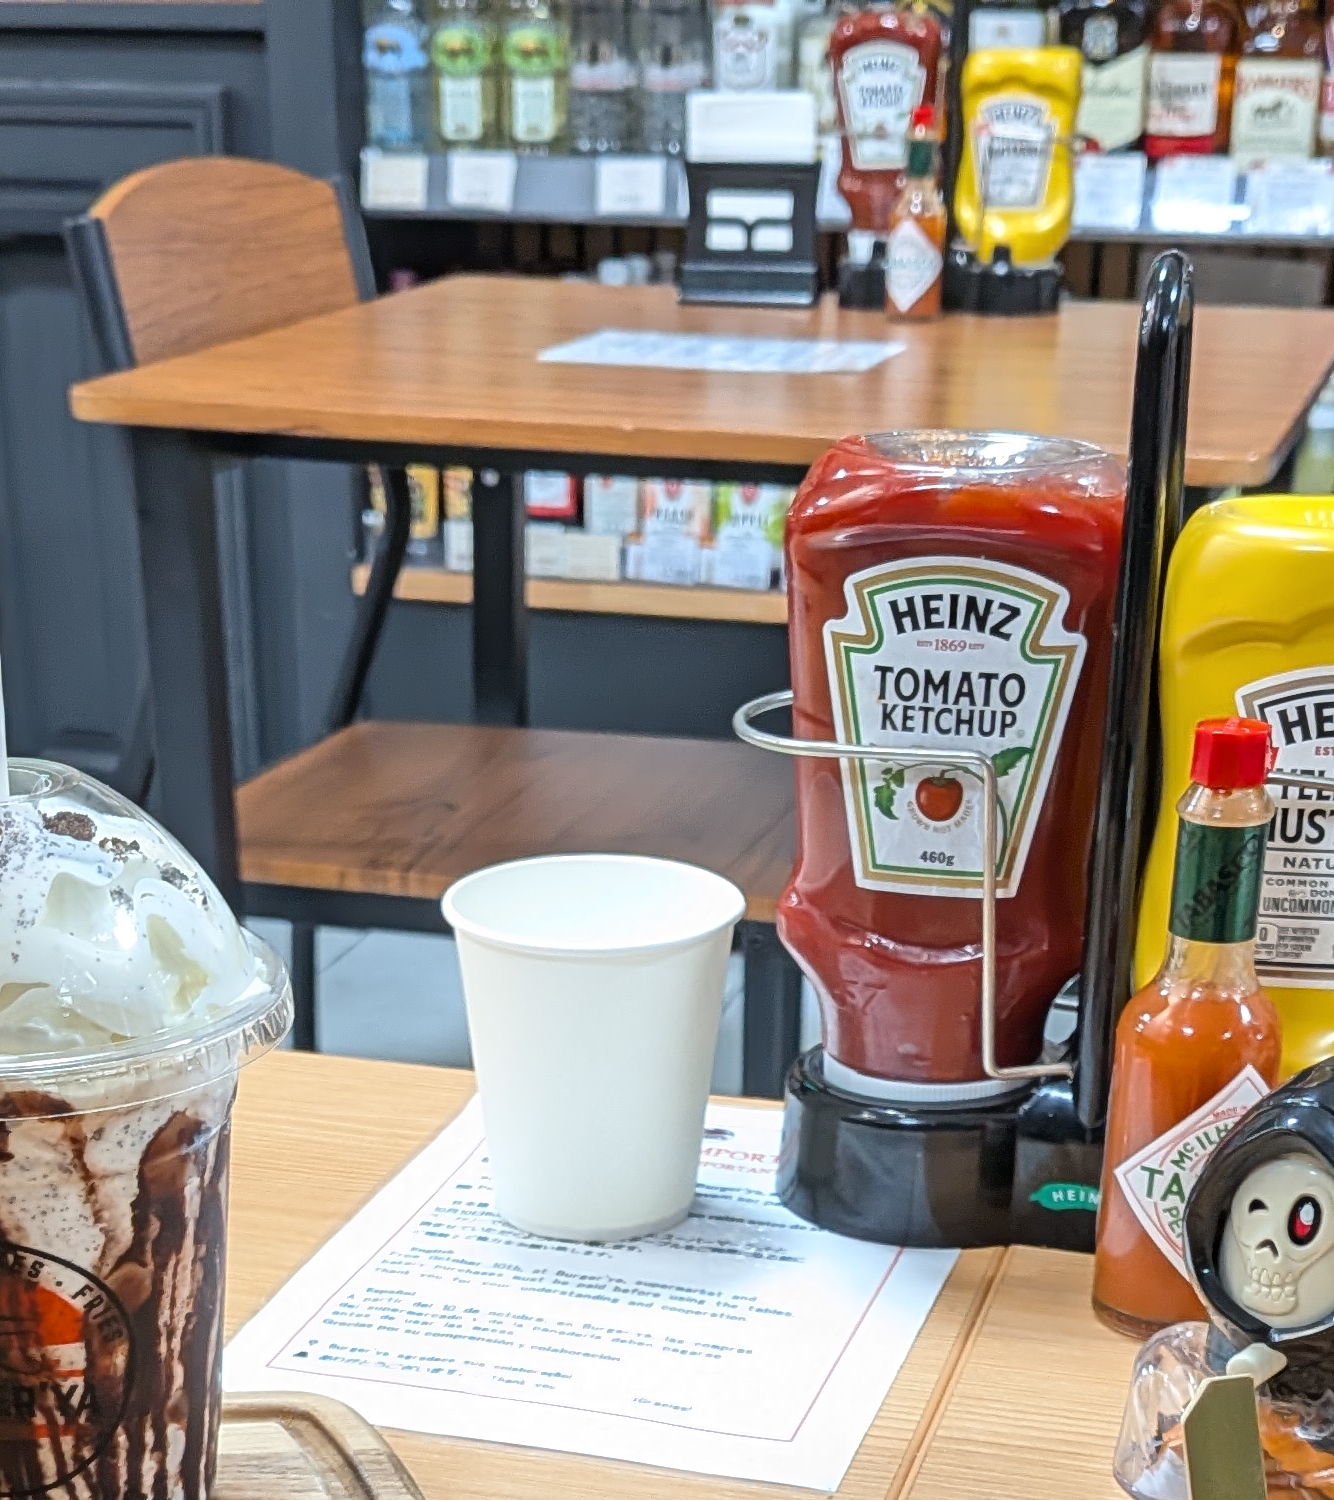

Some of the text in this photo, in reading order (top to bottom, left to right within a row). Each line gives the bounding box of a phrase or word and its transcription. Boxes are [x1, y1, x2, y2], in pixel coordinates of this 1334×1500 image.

[888, 593, 1021, 641] HEINZ
[934, 639, 967, 651] 1869
[874, 665, 1025, 708] TOMATO
[880, 703, 1017, 738] KETCHUP
[919, 851, 955, 866] 460g
[1266, 878, 1329, 888] COMMON
[1051, 1189, 1100, 1204] HEIN
[72, 1283, 124, 1343] FRIES
